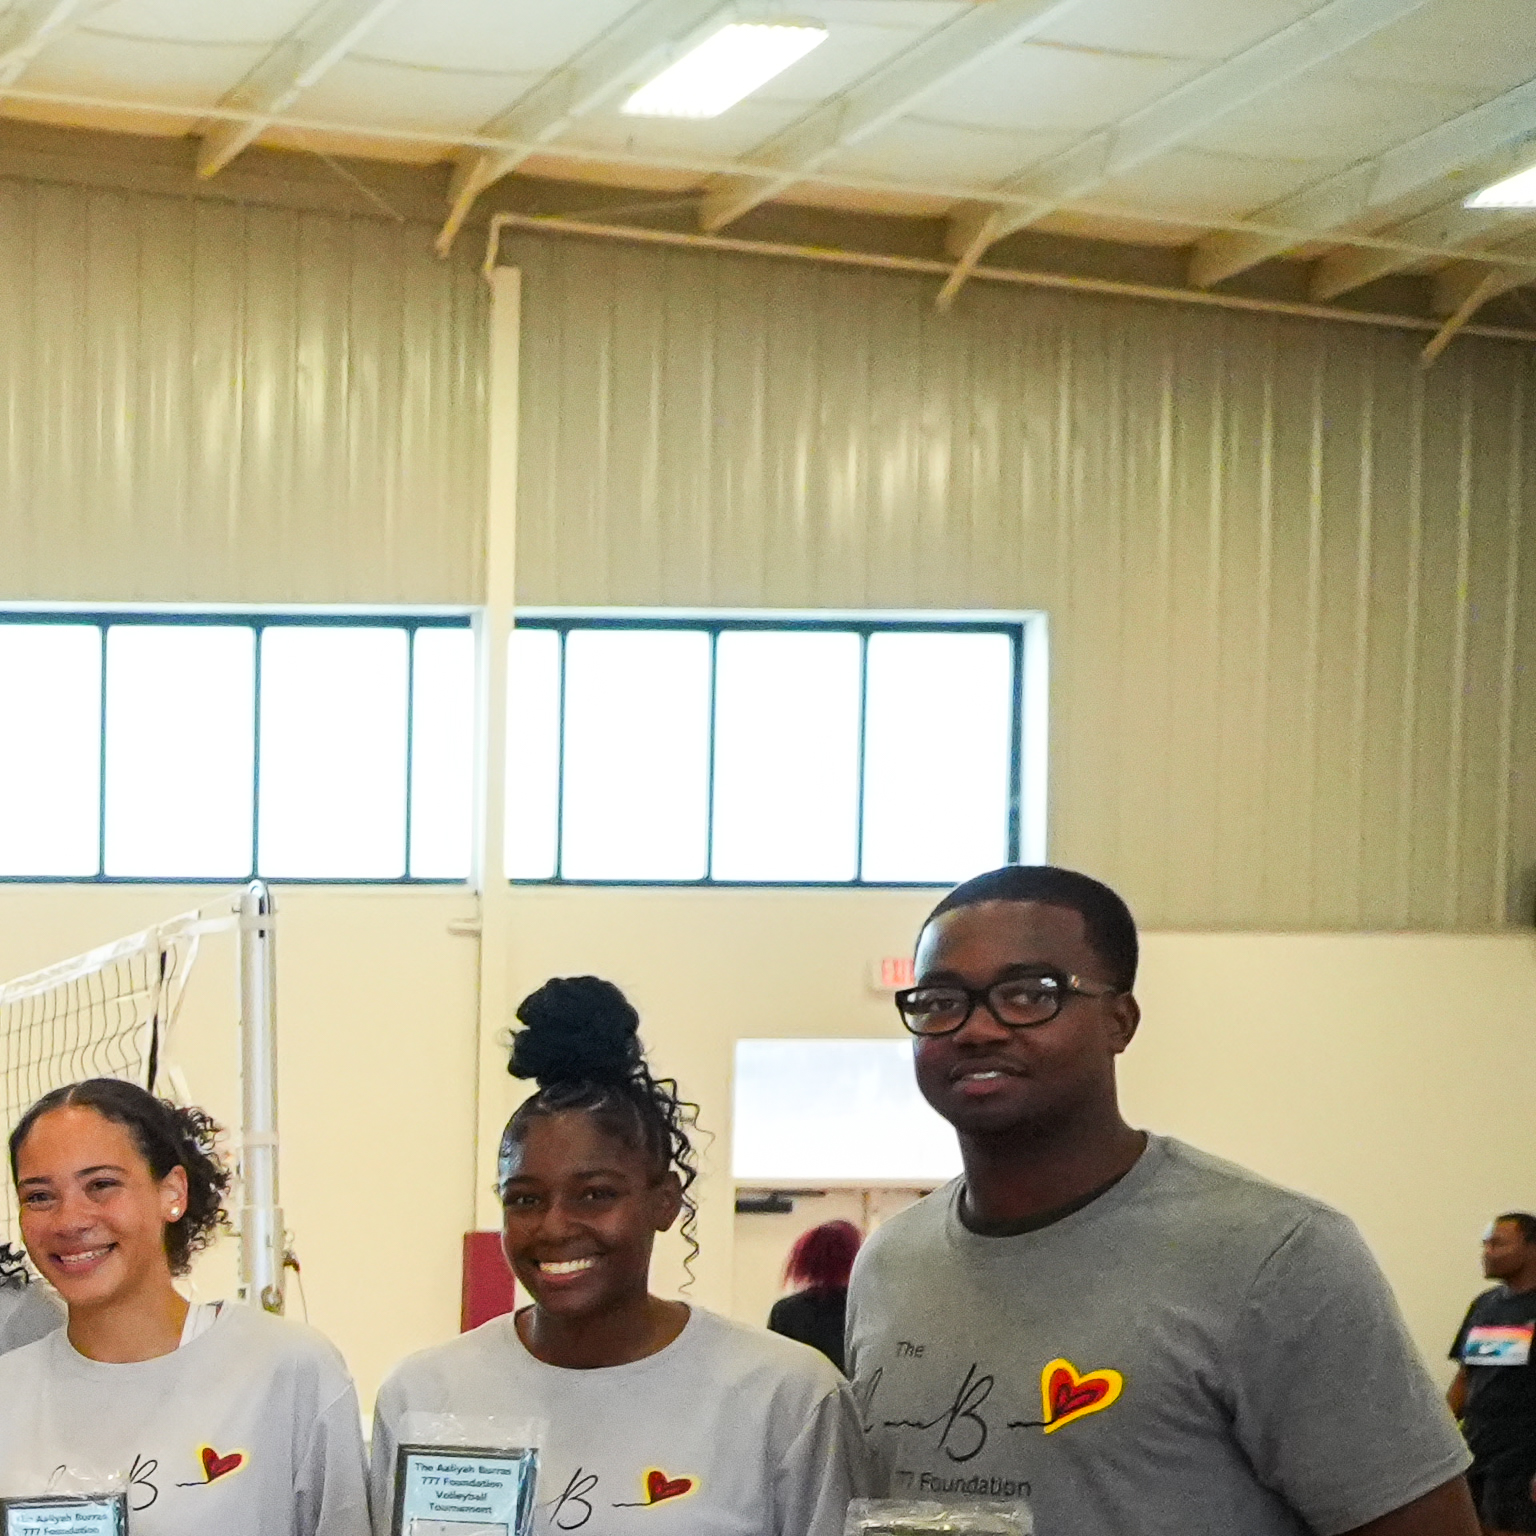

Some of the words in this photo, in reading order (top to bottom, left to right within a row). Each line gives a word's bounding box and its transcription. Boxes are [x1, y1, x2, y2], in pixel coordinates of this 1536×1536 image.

[895, 1341, 926, 1358] The
[415, 1463, 433, 1472] The
[422, 1477, 440, 1485] 777
[920, 1472, 1032, 1497] Foundation
[23, 1528, 40, 1536] 777
